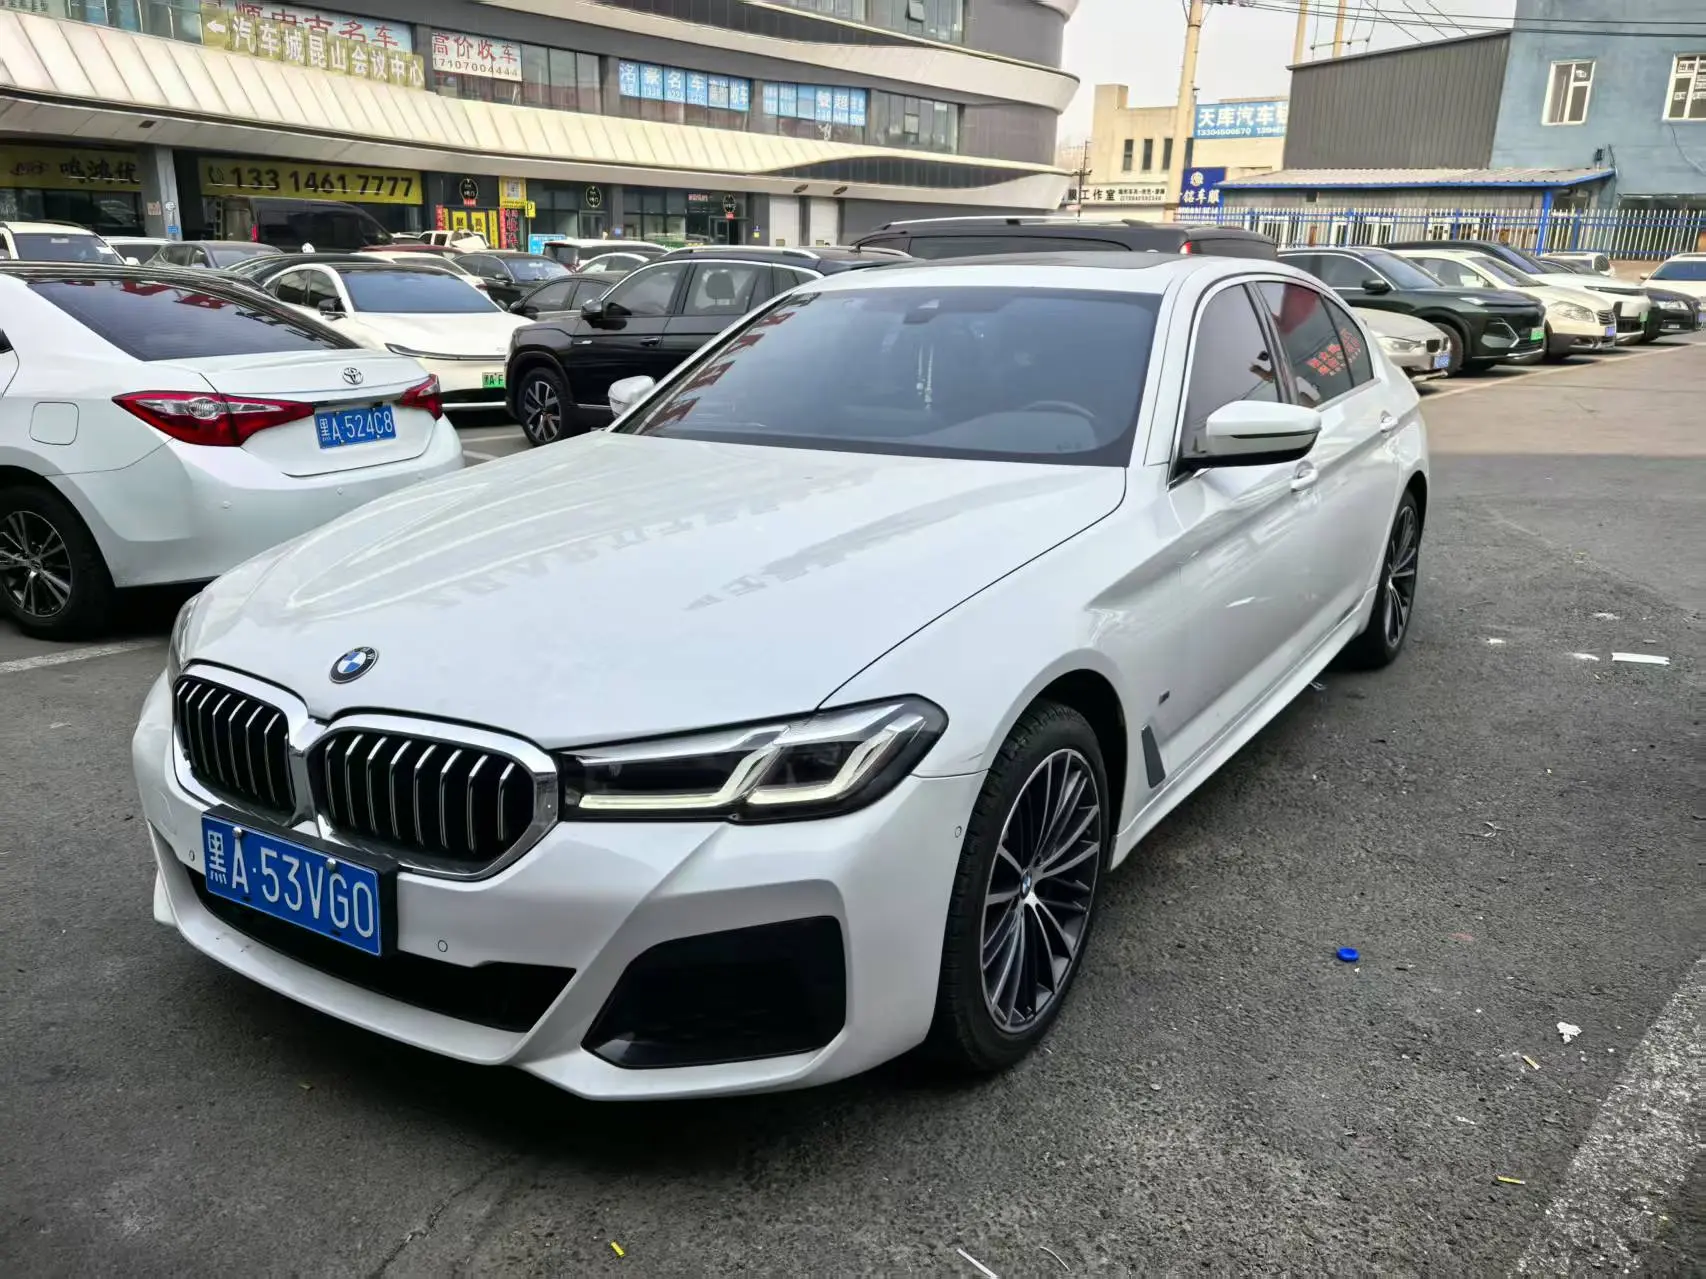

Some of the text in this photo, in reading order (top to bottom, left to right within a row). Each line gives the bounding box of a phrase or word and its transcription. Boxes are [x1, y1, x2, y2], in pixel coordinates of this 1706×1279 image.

[232, 15, 424, 85] 汽车城昆山会议中心
[433, 33, 517, 64] 高价收车
[230, 167, 413, 197] 133 1461 7777
[320, 412, 393, 442] 黑A·524C8
[207, 830, 374, 938] 黑A·53VG0
